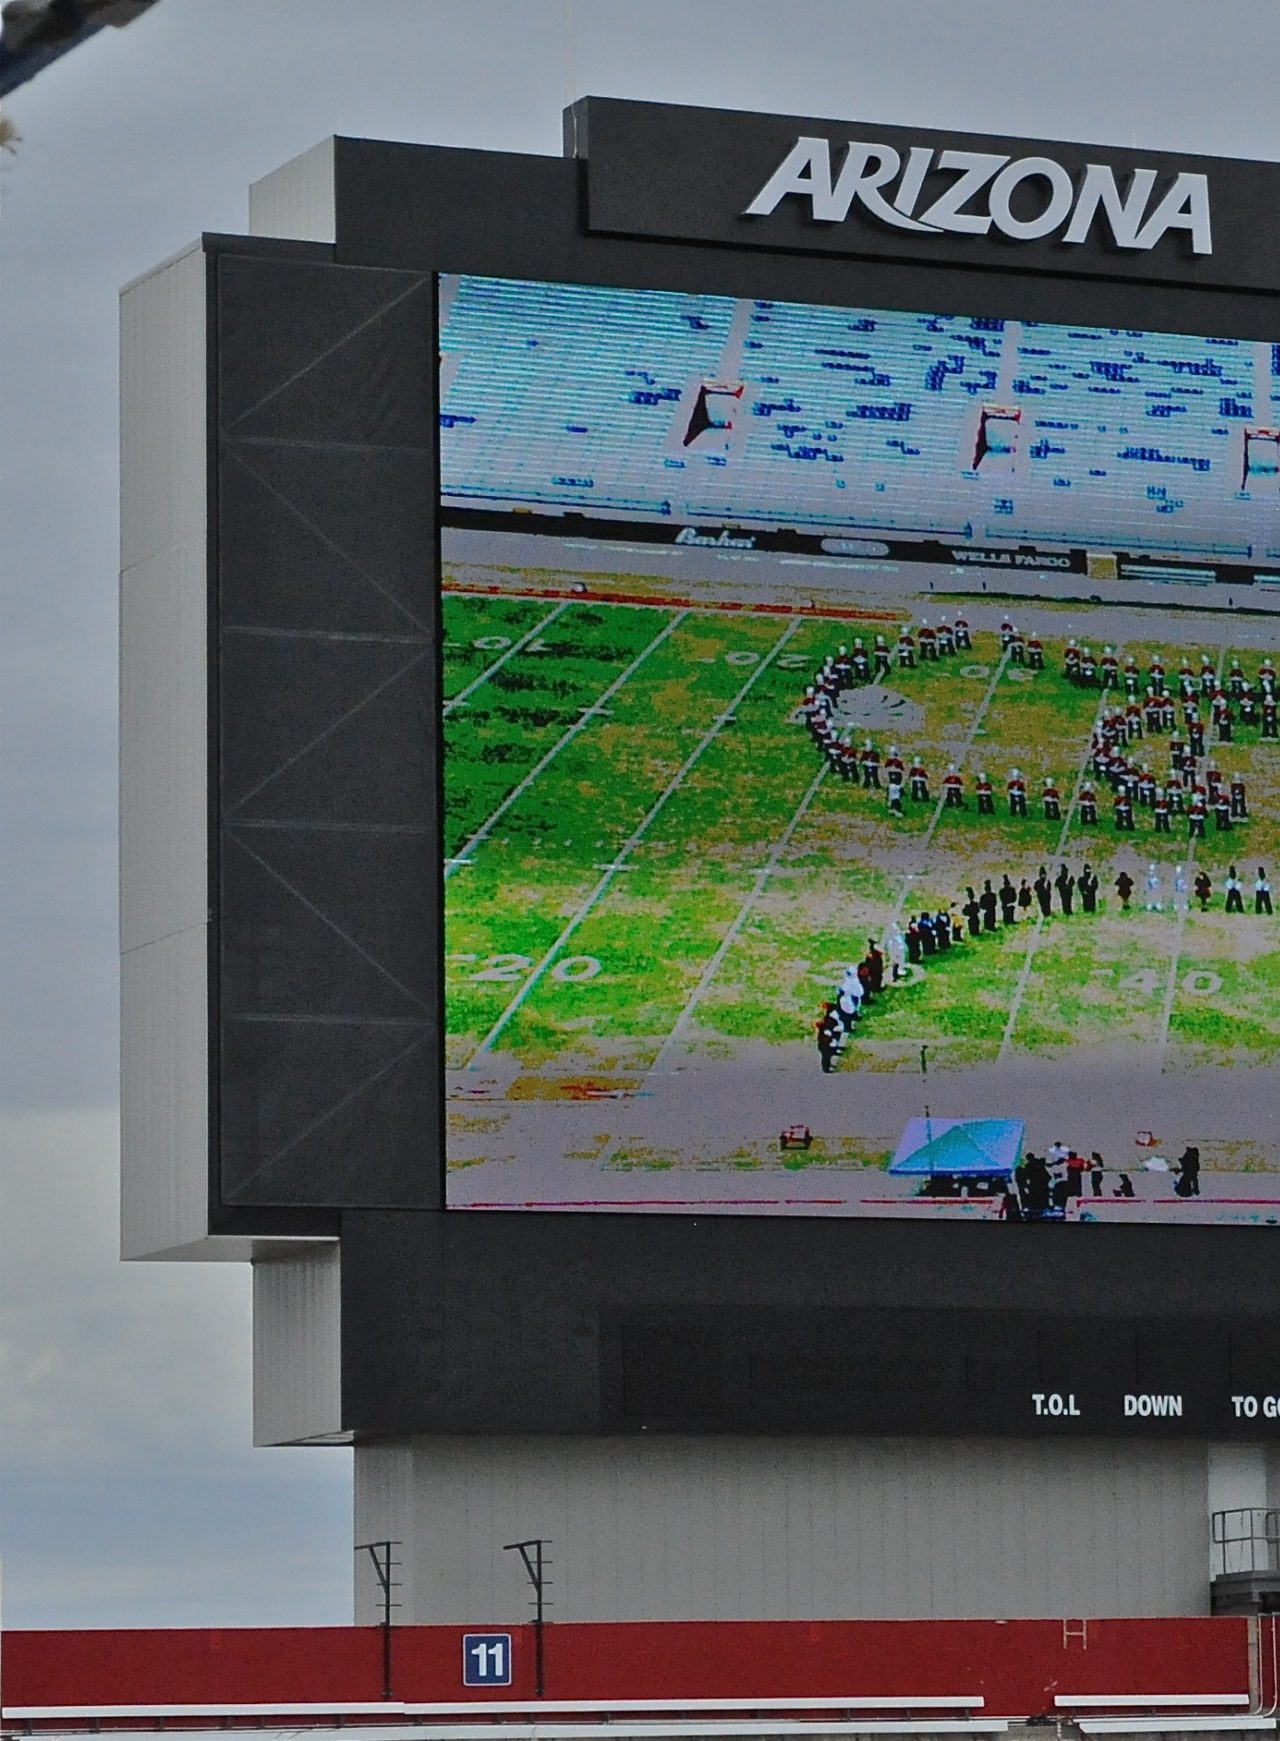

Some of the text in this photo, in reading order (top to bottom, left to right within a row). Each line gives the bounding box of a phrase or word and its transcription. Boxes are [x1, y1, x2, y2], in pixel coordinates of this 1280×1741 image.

[744, 136, 1213, 255] ARIZONA
[1032, 1394, 1081, 1416] T.O.L
[1124, 1394, 1183, 1417] DOWN
[1231, 1396, 1258, 1418] TO
[471, 1643, 504, 1677] 11
